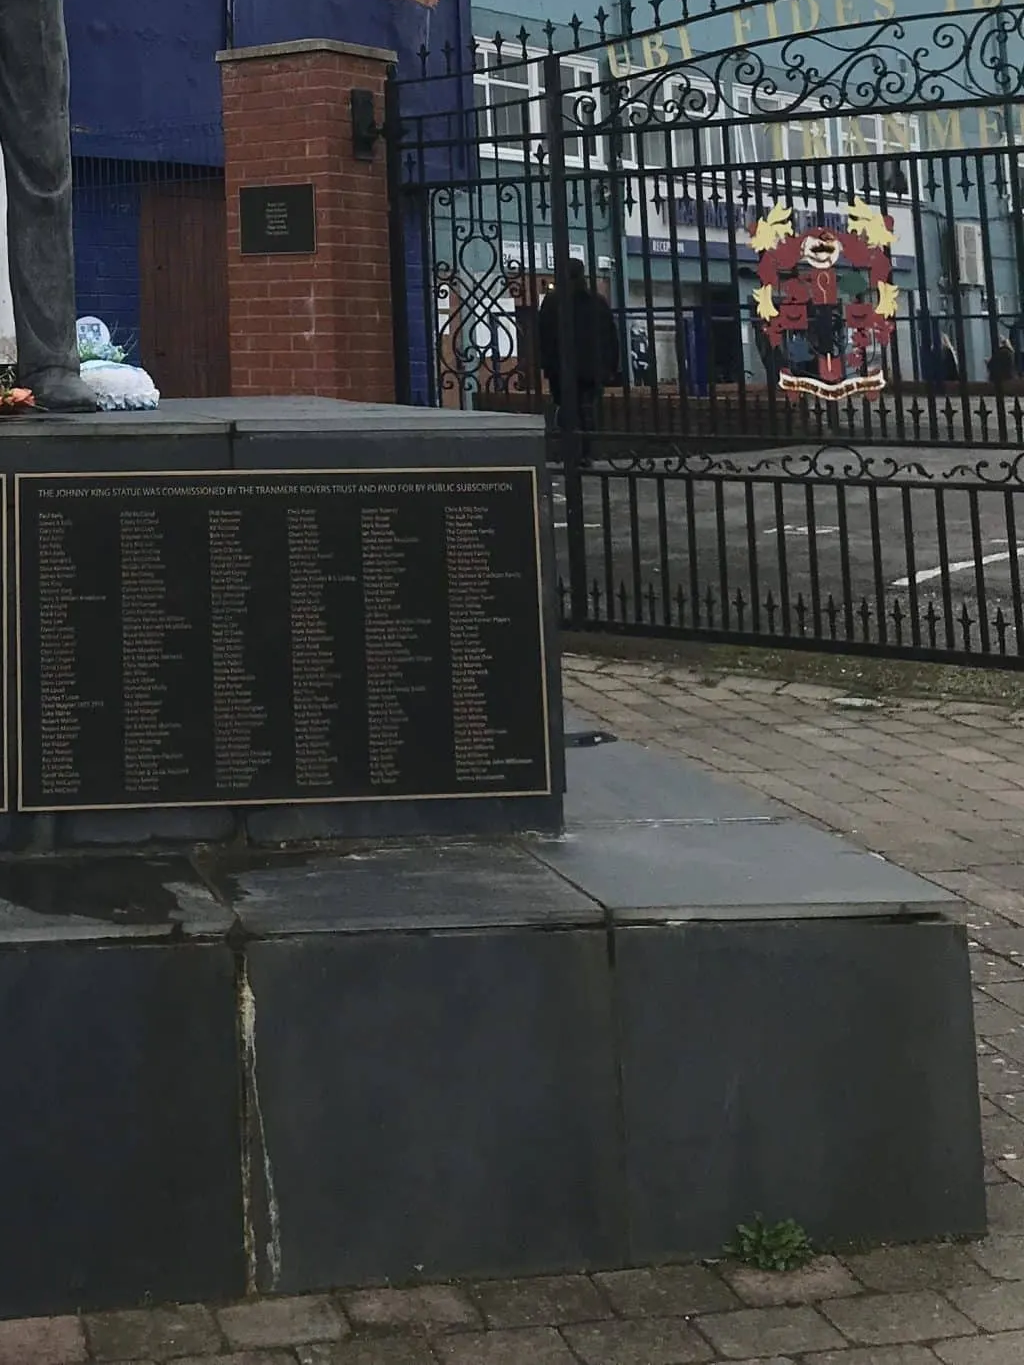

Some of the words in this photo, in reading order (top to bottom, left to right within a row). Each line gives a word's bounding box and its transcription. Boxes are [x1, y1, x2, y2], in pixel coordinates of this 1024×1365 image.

[607, 25, 693, 79] UBI
[652, 240, 685, 258] RECEPON
[38, 489, 54, 498] THE
[55, 488, 89, 498] JOHNNY
[91, 488, 111, 497] KING
[142, 487, 161, 496] WAS
[162, 486, 226, 496] COMMISSIONED
[227, 486, 238, 495] BY
[239, 486, 255, 495] THE
[256, 486, 299, 495] TRANMERE
[300, 485, 331, 495] ROVERS
[331, 484, 356, 494] TRUST
[358, 484, 377, 494] AND
[378, 484, 397, 493] PAID
[398, 483, 415, 493] FOR
[415, 483, 426, 493] BY
[427, 483, 454, 492] PUBLIC
[456, 482, 513, 492] SUBSCRIPTION
